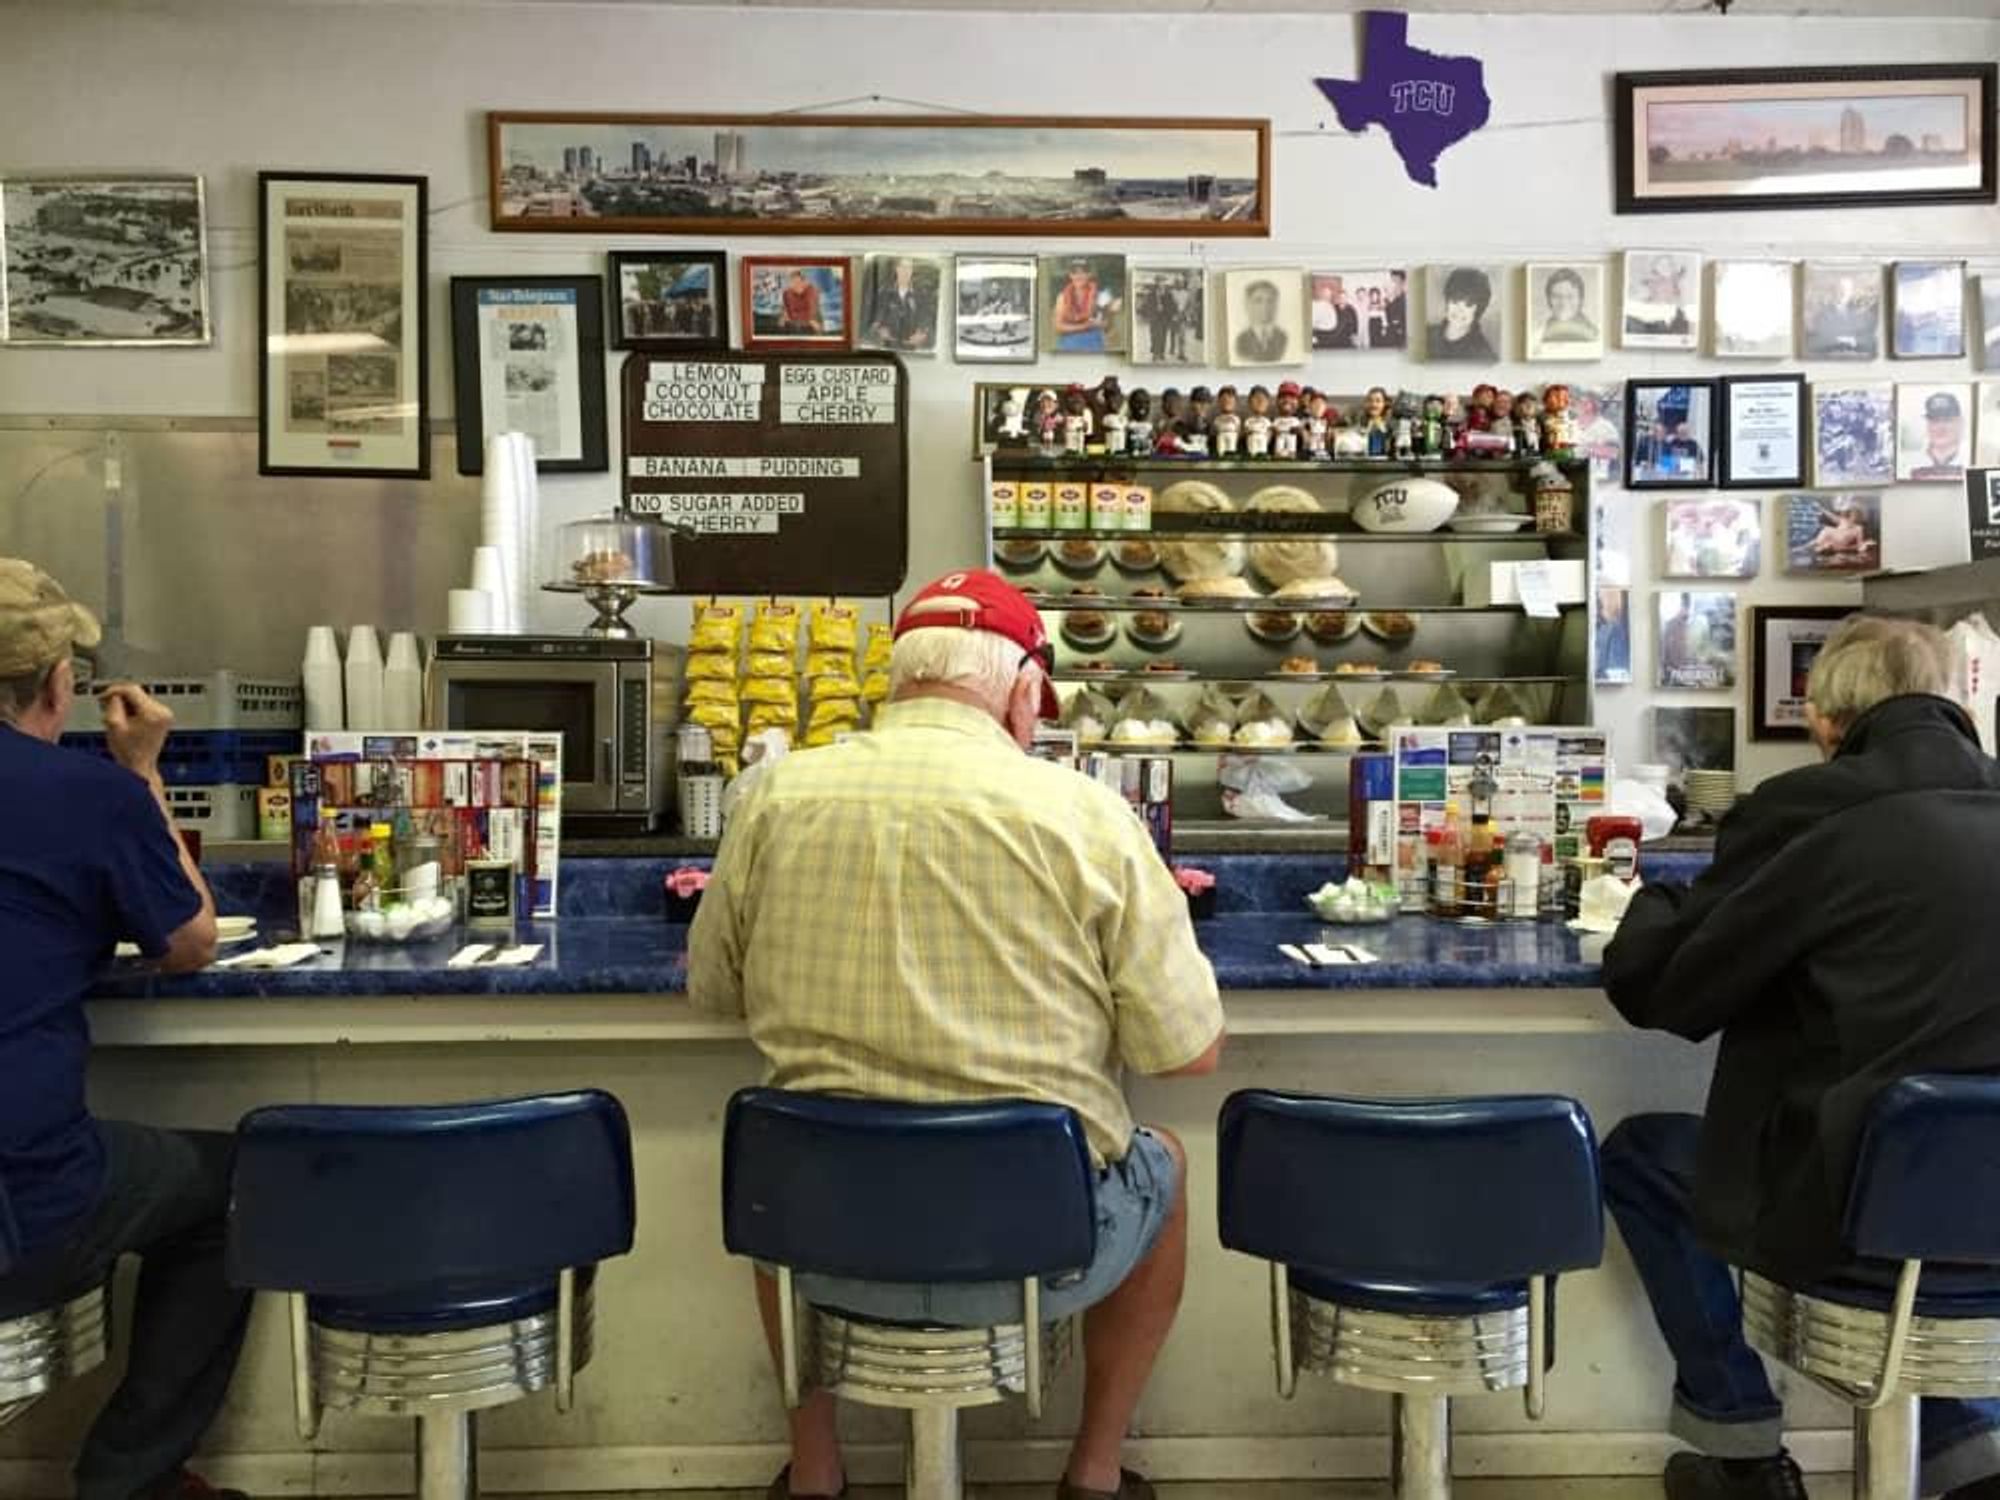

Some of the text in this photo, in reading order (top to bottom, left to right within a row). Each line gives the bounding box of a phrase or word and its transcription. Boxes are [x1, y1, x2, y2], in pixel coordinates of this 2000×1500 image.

[1390, 80, 1455, 116] TCU
[673, 364, 742, 381] LEMON
[784, 367, 889, 384] EGG CUSTARD
[656, 383, 751, 400] COCONUT
[807, 385, 867, 402] APPLE
[648, 402, 753, 419] CHOCOLATE
[798, 405, 877, 422] CHERRY
[645, 458, 845, 476] BANANA PUDDING
[635, 495, 800, 512] NO SUGAR ADDED
[1375, 488, 1408, 510] TCU
